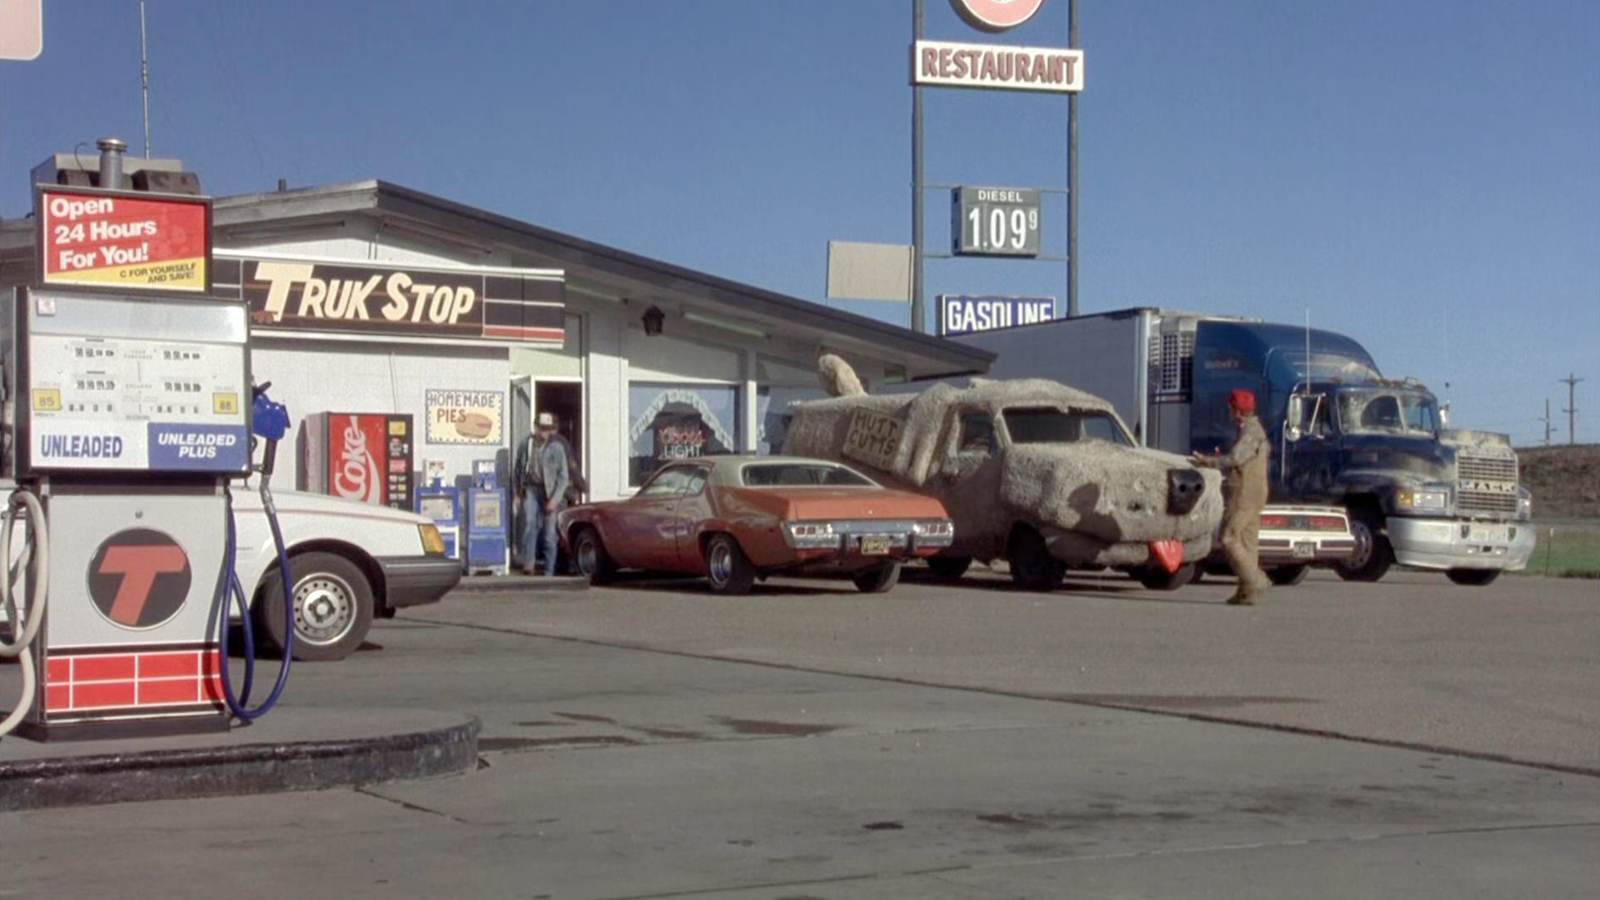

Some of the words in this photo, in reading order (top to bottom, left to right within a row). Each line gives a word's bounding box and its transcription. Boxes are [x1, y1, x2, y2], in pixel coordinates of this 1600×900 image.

[922, 47, 1078, 85] RESTAURANT
[978, 190, 1023, 202] DIESEL
[51, 198, 114, 221] Open
[55, 223, 85, 245] 24
[90, 220, 158, 241] Hours
[59, 250, 96, 270] For
[100, 241, 149, 265] You!
[129, 268, 148, 277] FOR
[149, 262, 196, 275] YOURSELF
[148, 274, 167, 283] AND
[170, 271, 195, 281] SAVE!
[254, 262, 383, 322] TRUK
[381, 272, 475, 325] STOP
[39, 396, 54, 407] 85
[436, 408, 467, 424] PIES
[854, 411, 898, 438] MUTT
[41, 435, 123, 458] UNLEADED
[158, 433, 236, 446] UNLEADED
[850, 429, 896, 456] CUTTS
[179, 446, 217, 458] PLUS
[334, 416, 366, 502] Coke
[1459, 481, 1517, 493] MACK
[98, 544, 187, 626] T
